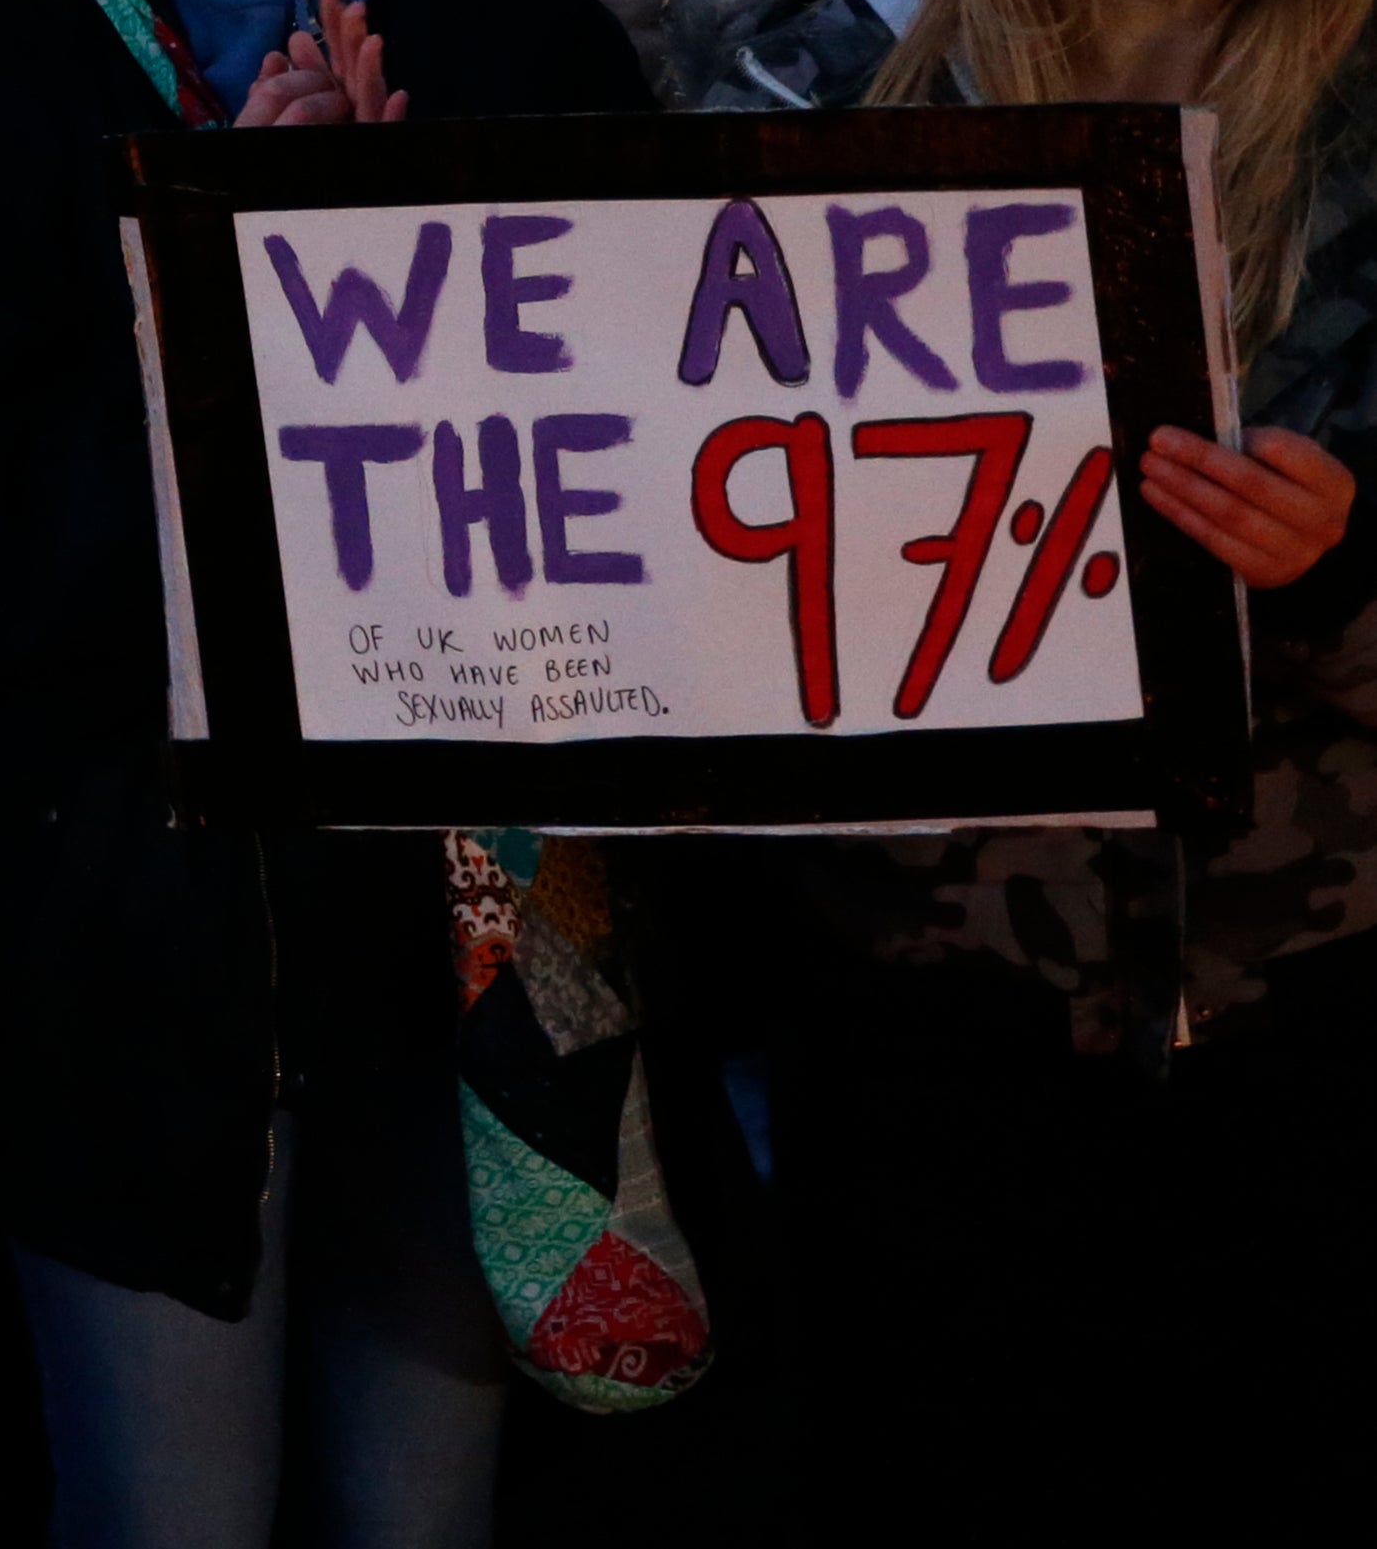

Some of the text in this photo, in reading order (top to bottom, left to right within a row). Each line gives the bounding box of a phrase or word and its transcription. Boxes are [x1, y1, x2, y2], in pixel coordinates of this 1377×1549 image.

[262, 196, 1093, 402] WE ARE
[278, 409, 1122, 728] THE 97%
[349, 620, 610, 655] OF UK WOMEN
[352, 653, 611, 686] WHO HAVE BEEN
[396, 685, 670, 729] SEXUALLY ASSAULTED.
